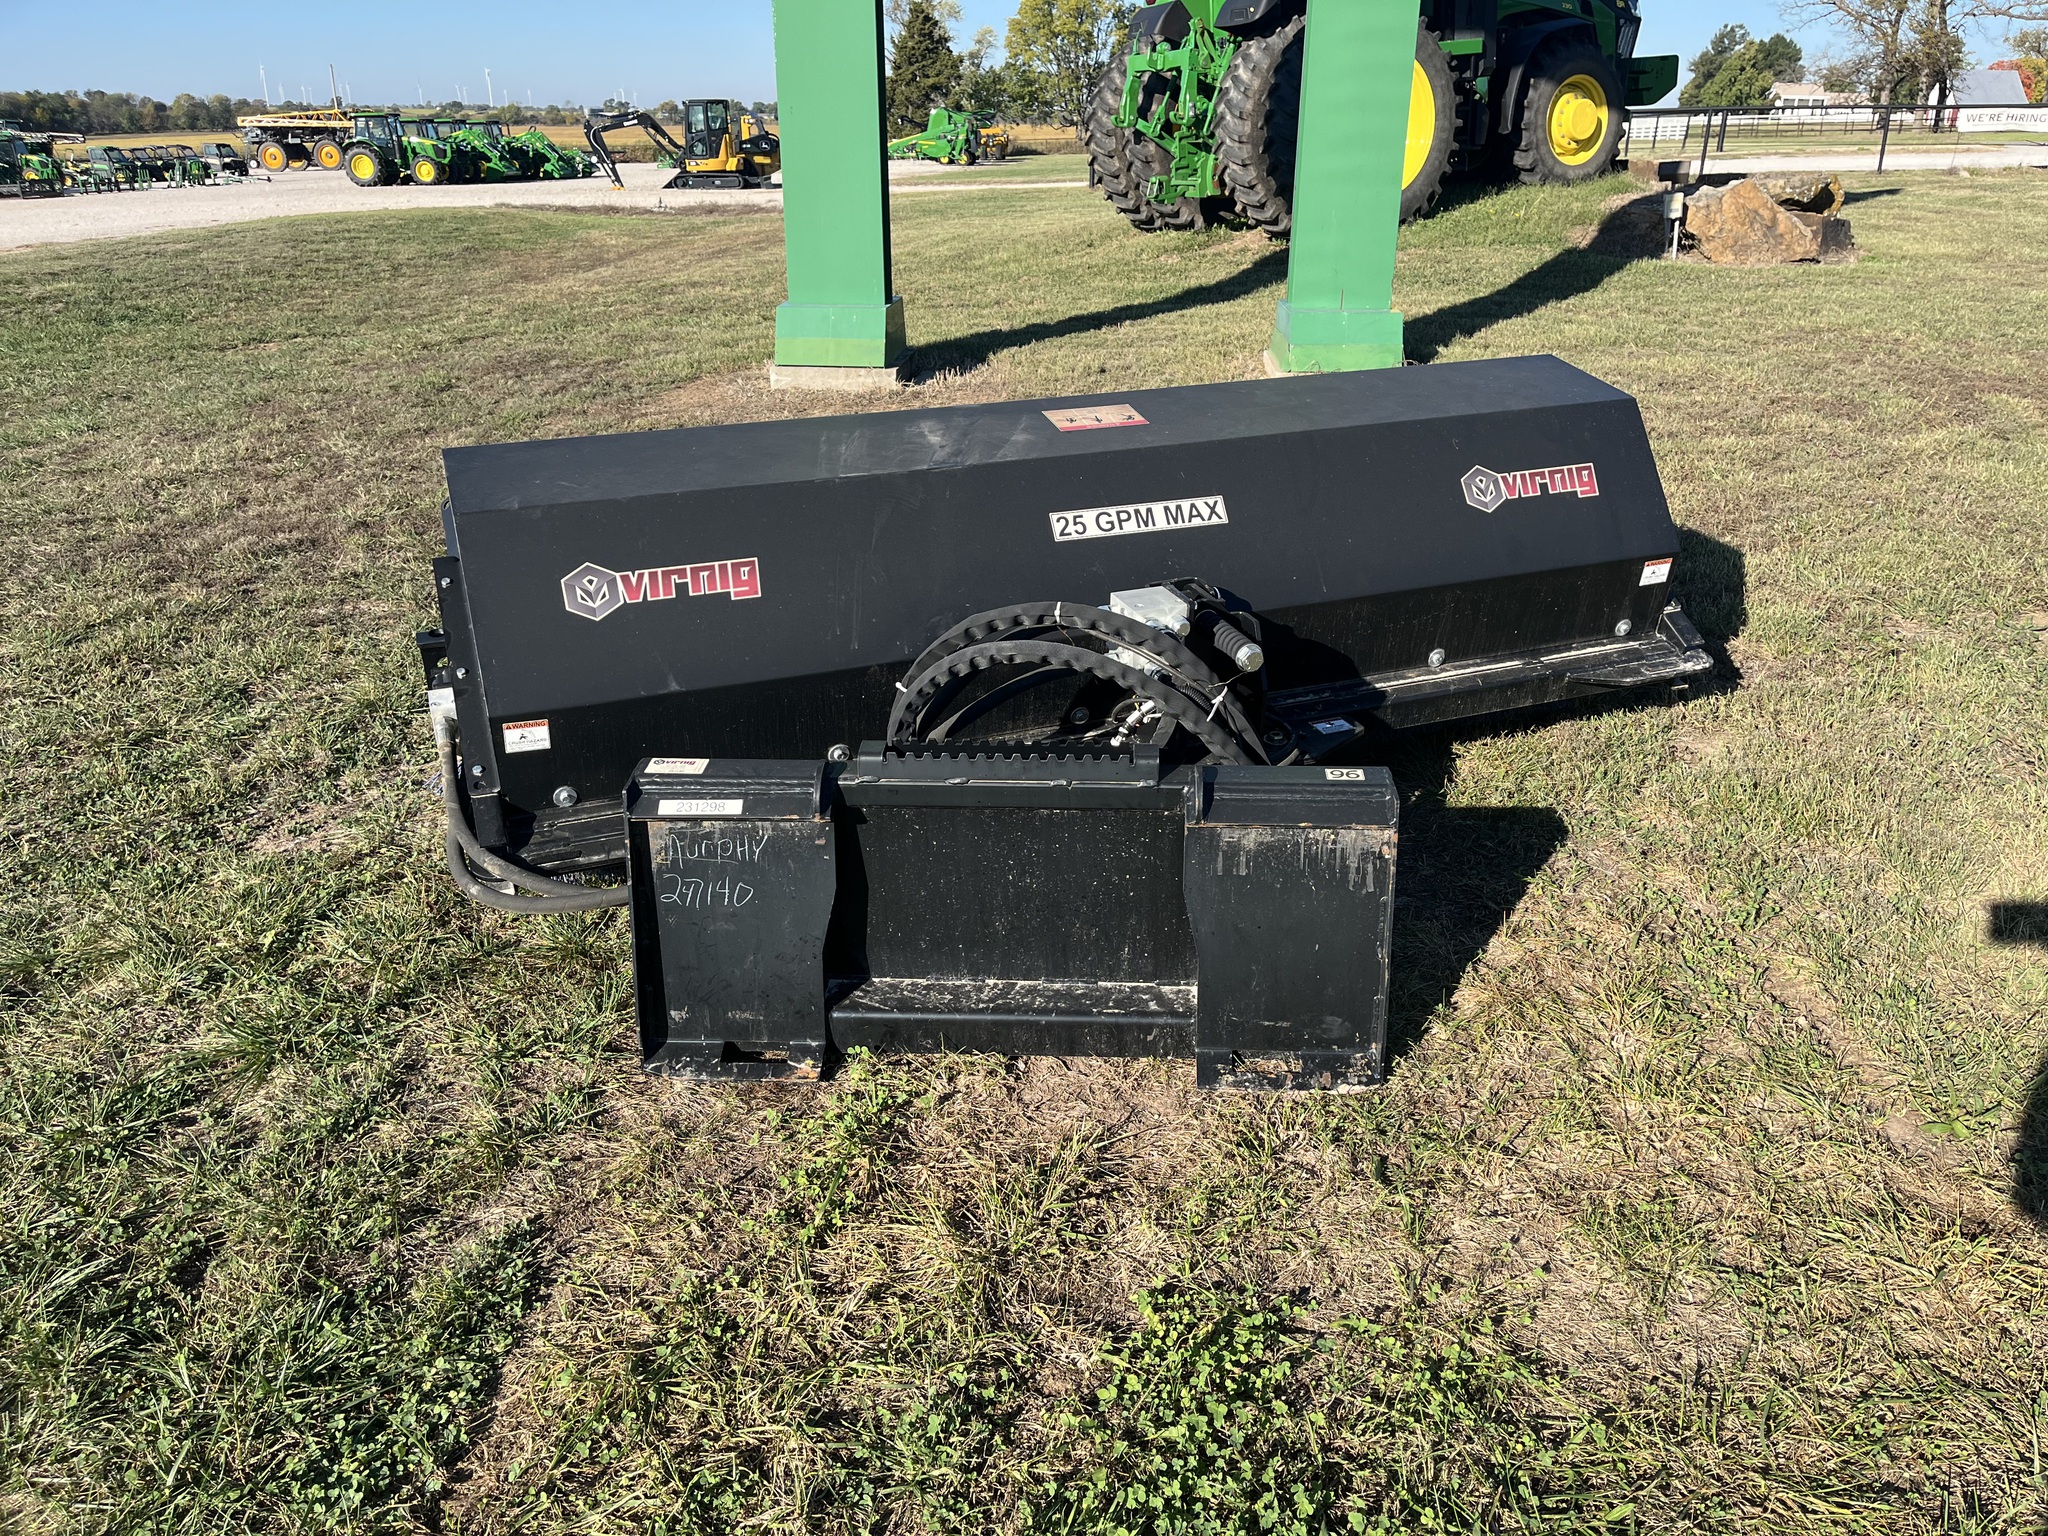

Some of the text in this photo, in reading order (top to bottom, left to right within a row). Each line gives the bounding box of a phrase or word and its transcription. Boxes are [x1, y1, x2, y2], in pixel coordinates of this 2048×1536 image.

[1966, 113, 2047, 123] WE'RE HIRING
[1055, 500, 1223, 537] 25 GPM MAX
[511, 721, 546, 729] WARNING
[1329, 769, 1361, 780] 96
[675, 801, 726, 813] 231298
